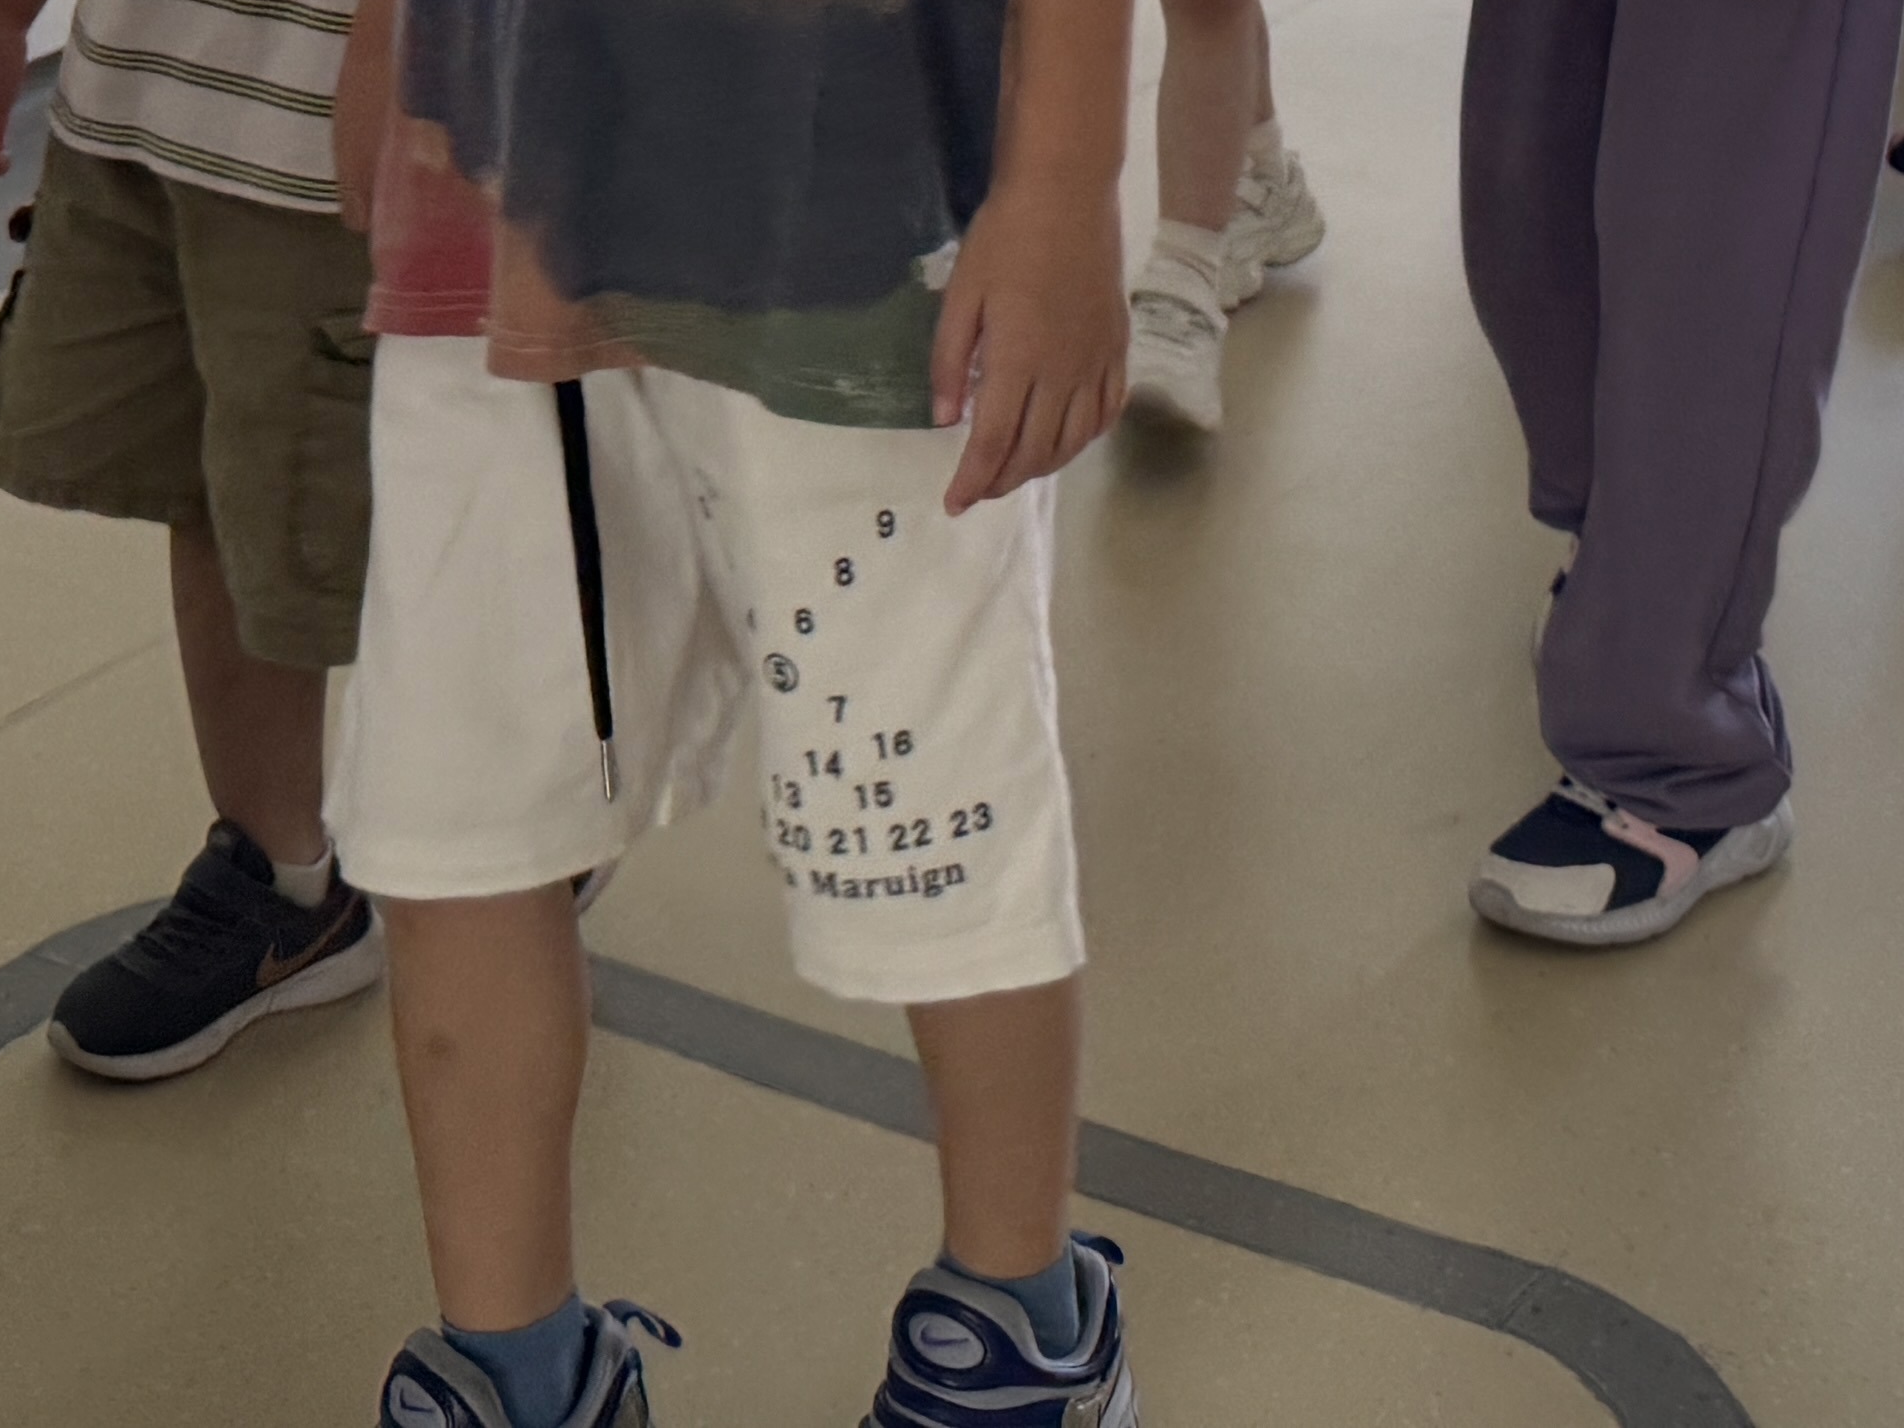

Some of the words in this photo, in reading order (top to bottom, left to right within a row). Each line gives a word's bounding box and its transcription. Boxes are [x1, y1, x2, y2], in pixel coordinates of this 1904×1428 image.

[876, 509, 896, 539] 9
[834, 557, 855, 586] 8
[795, 608, 815, 635] 6
[827, 695, 848, 723] 7
[804, 749, 845, 781] 14
[853, 781, 895, 810] 15
[827, 826, 870, 856] 21
[887, 817, 934, 852] 22
[950, 802, 993, 839] 23
